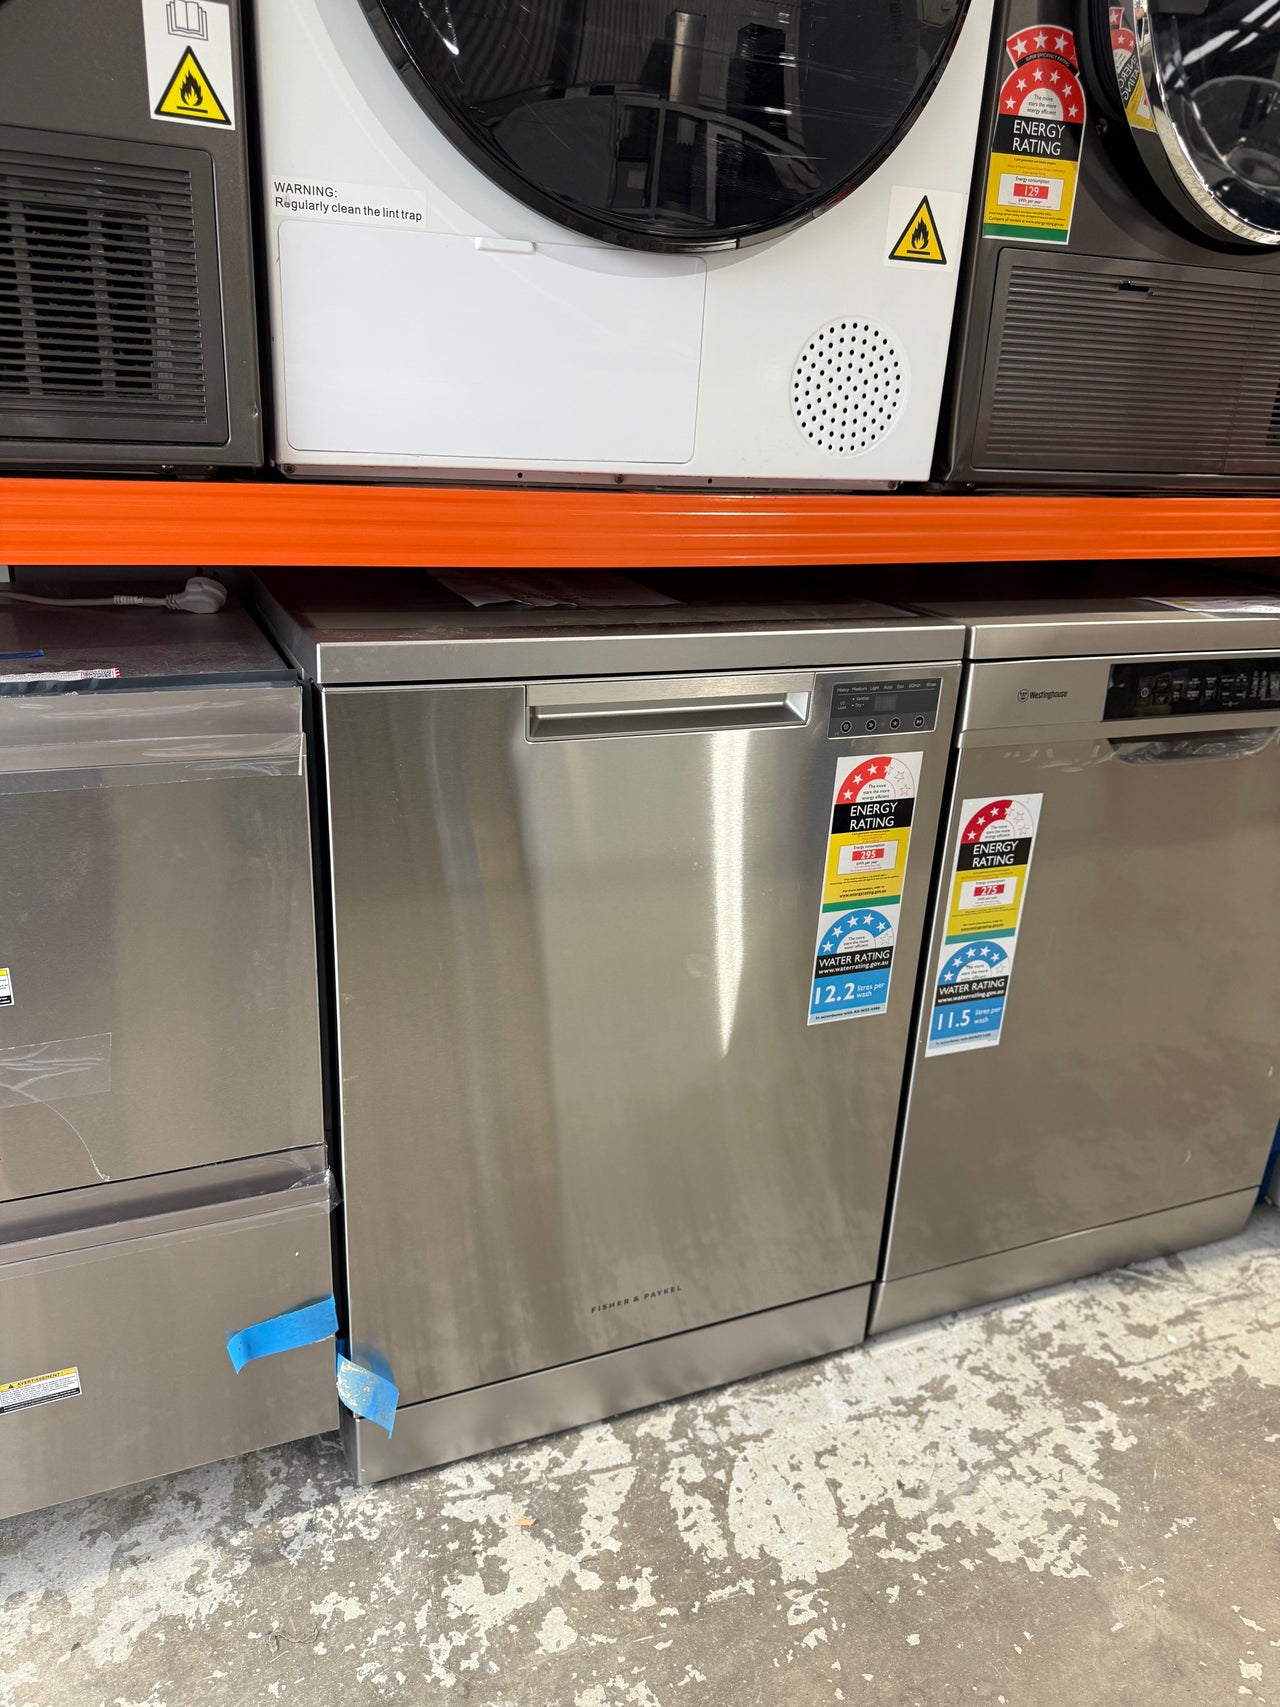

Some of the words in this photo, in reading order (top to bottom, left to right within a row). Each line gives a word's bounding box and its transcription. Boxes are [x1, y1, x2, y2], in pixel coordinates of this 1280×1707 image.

[1014, 120, 1066, 139] ENERGY
[1012, 138, 1062, 156] RATING
[274, 182, 338, 198] WARNING:
[1024, 186, 1039, 196] 129
[275, 197, 329, 214] Regularly
[332, 203, 361, 215] clean
[364, 206, 380, 217] the
[383, 208, 400, 219] lint
[401, 210, 422, 222] trap
[1030, 690, 1068, 700] Westinghouse
[850, 802, 898, 817] ENERGY
[850, 816, 895, 830] RATING
[860, 850, 876, 859] 295
[973, 840, 1018, 855] ENERGY
[972, 854, 1014, 868] RATING
[981, 887, 997, 895] 275
[819, 955, 852, 967] WATER
[855, 949, 890, 962] RATING
[819, 960, 889, 975] www.waterrating.gov.au
[814, 982, 855, 1005] 12.2
[857, 984, 873, 992] litres
[874, 983, 885, 991] per
[939, 984, 970, 995] WATER
[972, 979, 1005, 991] RATING
[938, 990, 1004, 1003] www.waterrating.gov.au
[938, 1009, 971, 1030] 11.5
[991, 1007, 1001, 1015] per
[591, 1298, 629, 1314] FISHER
[644, 1286, 682, 1300] PAYKEL
[17, 1372, 60, 1386] AVERTISSEMENT
